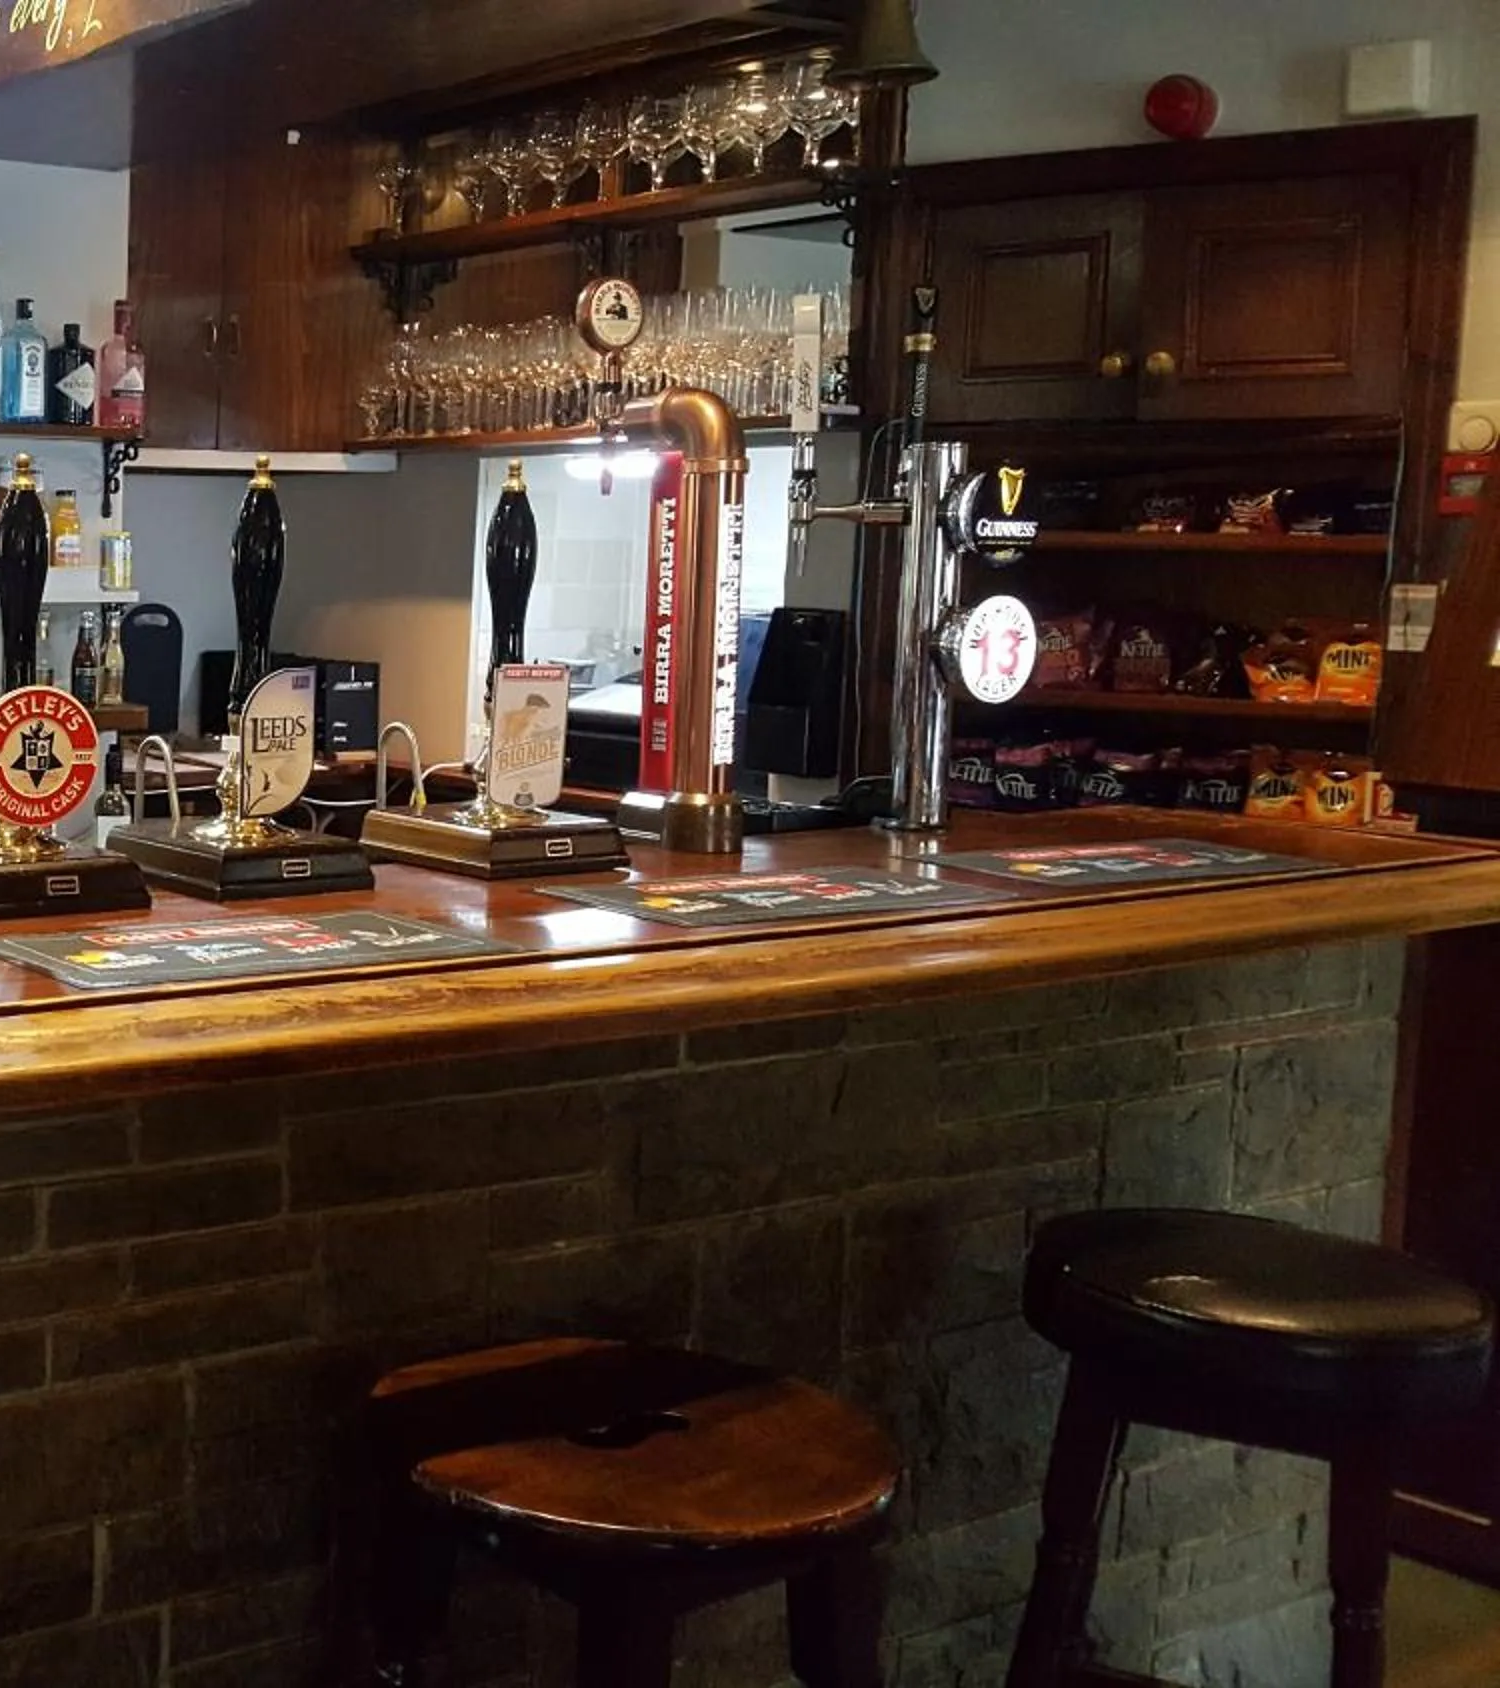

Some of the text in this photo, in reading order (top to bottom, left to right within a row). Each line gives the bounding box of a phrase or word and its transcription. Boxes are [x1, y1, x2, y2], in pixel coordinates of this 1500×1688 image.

[975, 517, 1039, 538] GUINNESS
[657, 496, 677, 617] MORETTI
[654, 622, 672, 705] BIRRA
[973, 627, 1022, 677] 13
[249, 715, 308, 754] LEEDS
[51, 777, 86, 813] CASK
